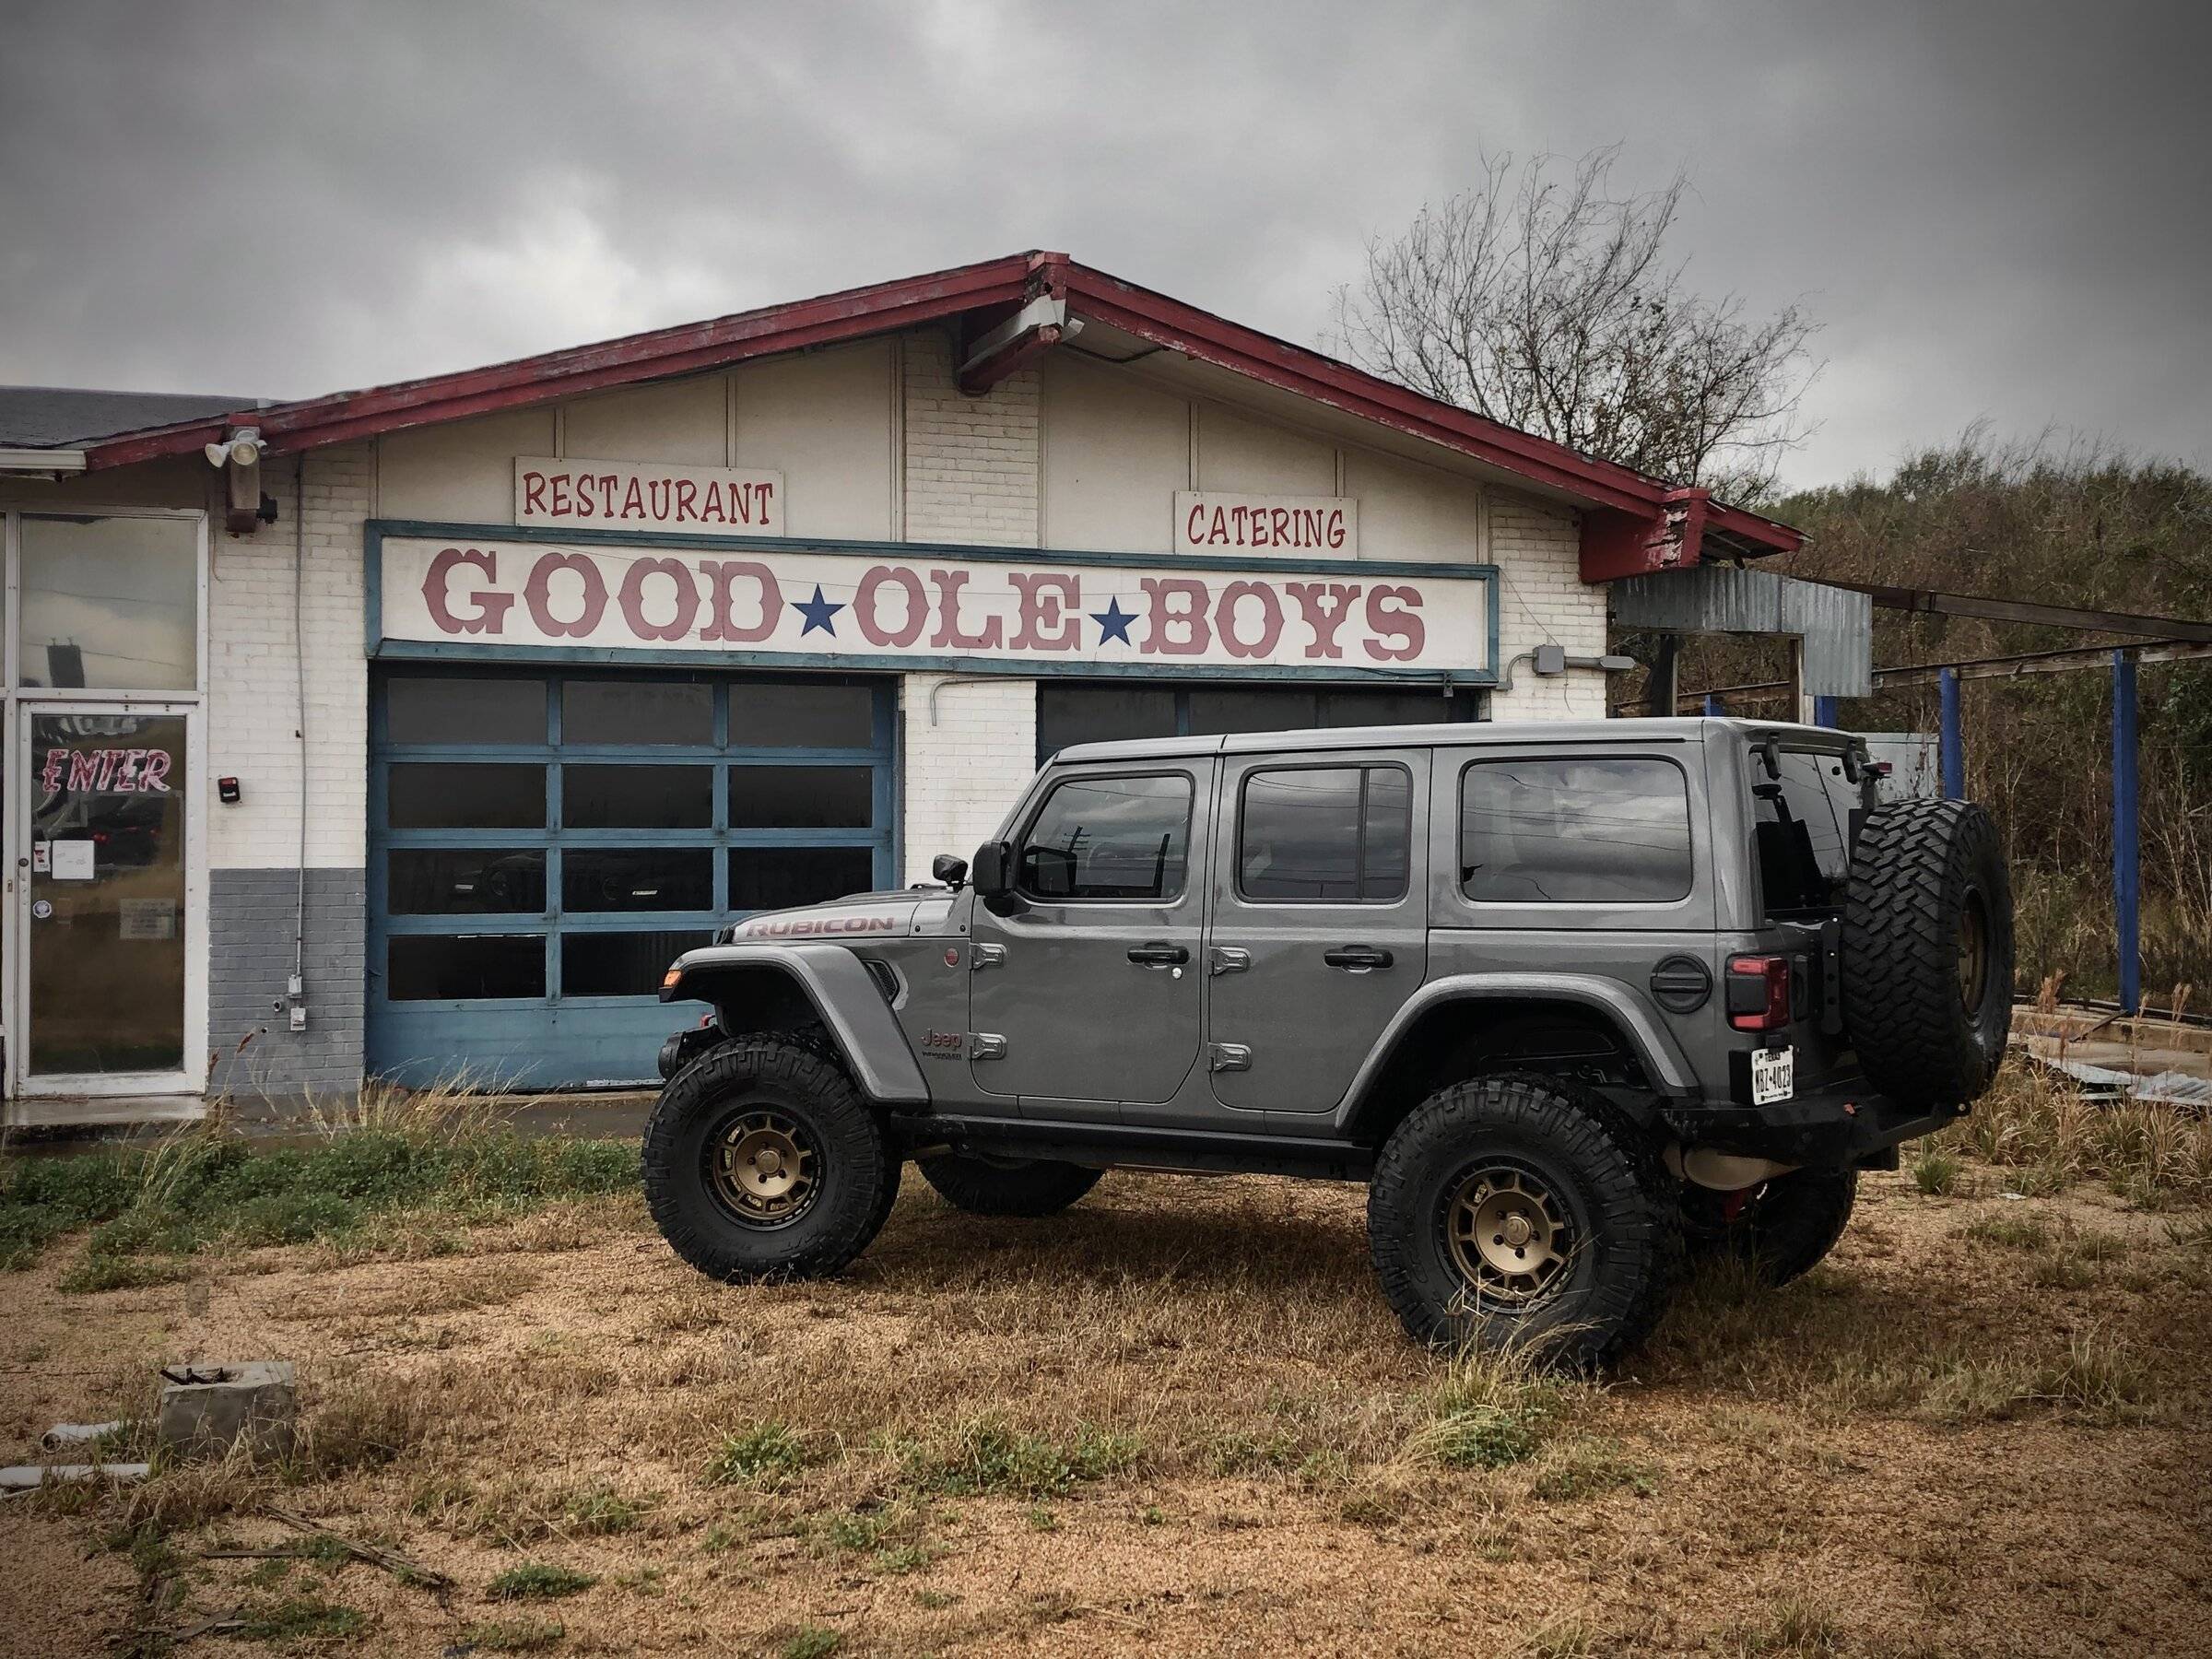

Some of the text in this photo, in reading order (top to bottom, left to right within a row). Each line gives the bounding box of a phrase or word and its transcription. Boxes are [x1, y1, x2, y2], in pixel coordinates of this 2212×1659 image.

[523, 471, 773, 525] RESTAURANT
[1186, 503, 1347, 548] CATERING
[420, 547, 1426, 662] GOOD OLE BOYS
[42, 748, 171, 793] ENTER
[746, 917, 895, 937] RUBICON
[921, 1028, 962, 1051] Jeep
